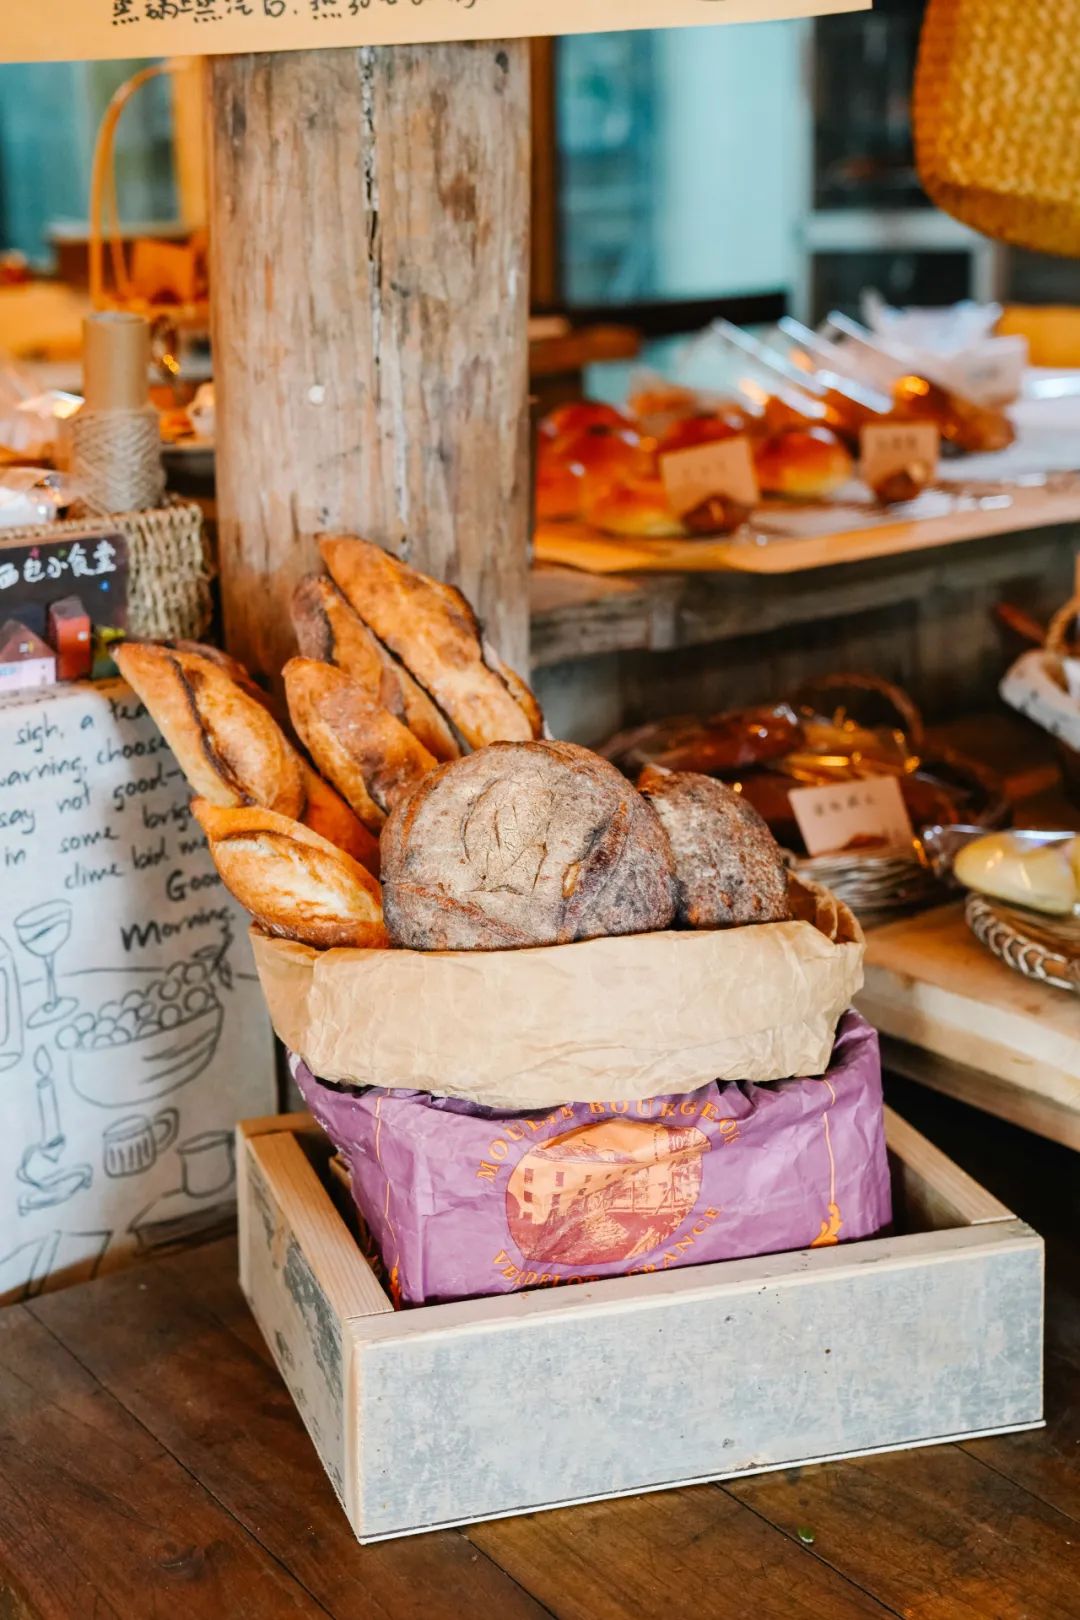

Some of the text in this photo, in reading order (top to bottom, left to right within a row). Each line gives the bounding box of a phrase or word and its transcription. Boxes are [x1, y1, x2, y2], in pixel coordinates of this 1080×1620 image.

[80, 714, 94, 730] a
[0, 808, 36, 835] say
[56, 780, 93, 814] not
[4, 846, 27, 867] in
[59, 826, 119, 854] some
[131, 836, 170, 869] bid
